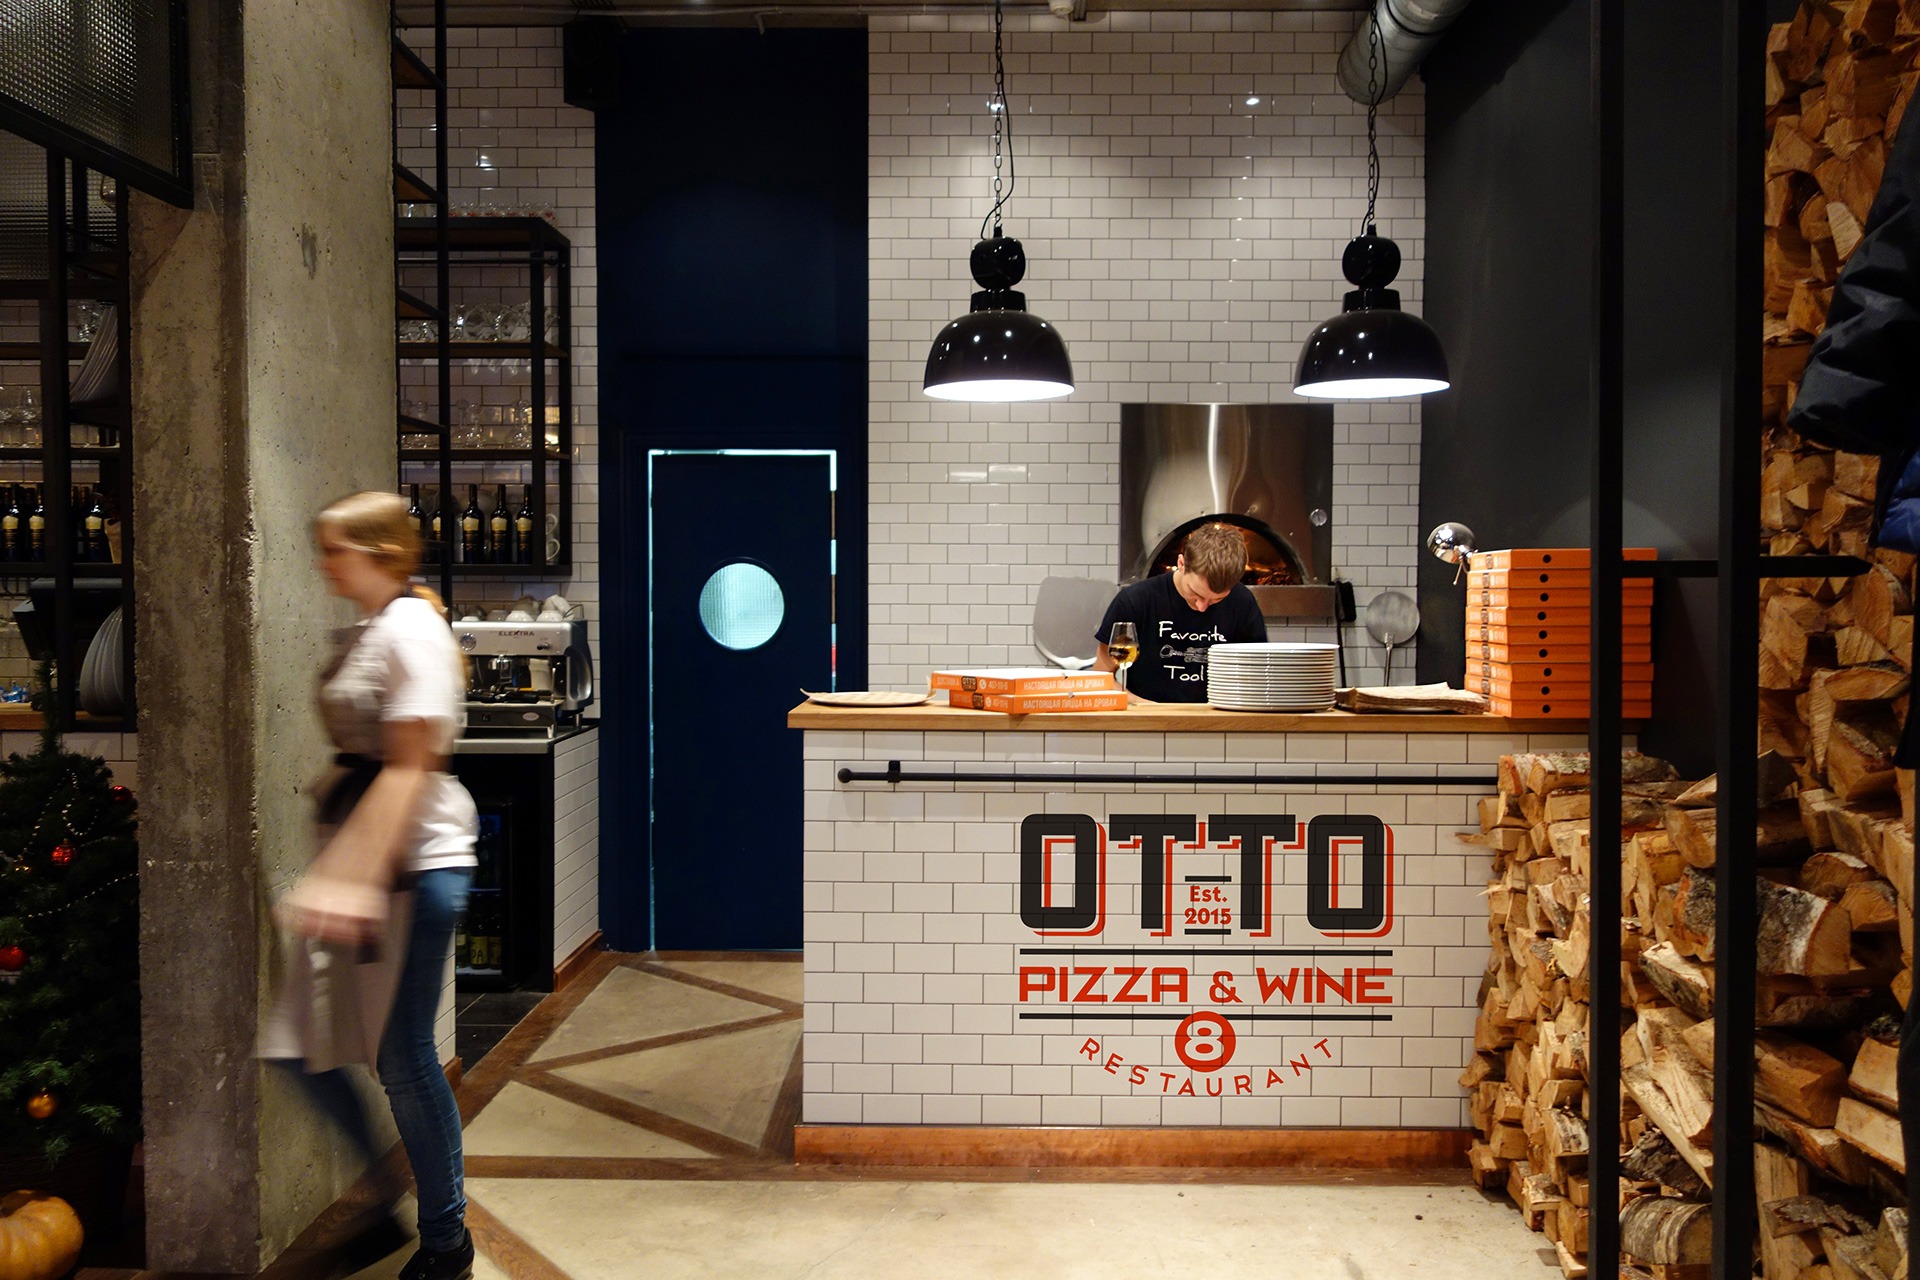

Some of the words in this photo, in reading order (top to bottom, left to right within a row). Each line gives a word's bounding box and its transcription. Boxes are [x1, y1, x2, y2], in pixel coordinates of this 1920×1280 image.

[498, 629, 535, 637] ELEKTRA
[1158, 620, 1227, 642] Favorite
[1163, 664, 1205, 682] Tool
[1020, 813, 1394, 937] OTTO
[1189, 885, 1228, 903] Est.
[1184, 907, 1232, 925] 2015
[1019, 966, 1189, 1003] PIZZA
[1209, 970, 1244, 1004] &
[1255, 966, 1393, 1005] WINE
[1182, 1017, 1226, 1063] 8
[1078, 1036, 1334, 1098] RESTAURANT
